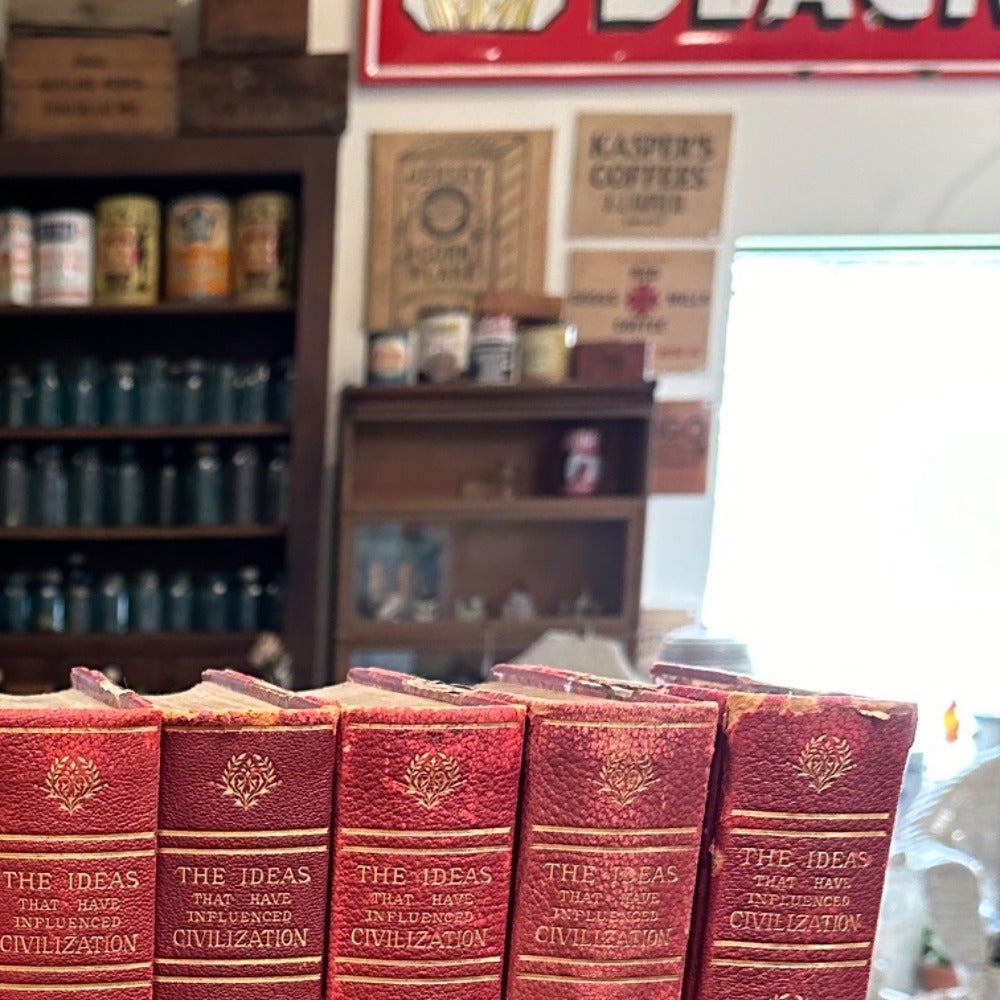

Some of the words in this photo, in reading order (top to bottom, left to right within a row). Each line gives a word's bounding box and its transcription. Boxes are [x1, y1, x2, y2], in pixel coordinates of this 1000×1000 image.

[588, 133, 715, 160] KASPER'S
[588, 163, 708, 191] COFFEES
[740, 847, 793, 868] THE
[806, 851, 870, 868] IDEAS
[3, 871, 52, 891] THE
[68, 871, 140, 891] IDEAS
[176, 866, 226, 886] THE
[240, 866, 311, 886] IDEAS
[356, 864, 405, 885] THE
[423, 867, 493, 886] IDEAS
[753, 875, 796, 889] THAT
[813, 876, 851, 889] HAVE
[19, 897, 59, 912] THAT
[76, 898, 120, 912] HAVE
[192, 892, 232, 906] THAT
[249, 892, 291, 906] HAVE
[372, 892, 414, 906] THAT
[432, 893, 475, 906] HAVE
[746, 892, 850, 907] INFLUENCED
[14, 916, 122, 929] INFLUENCED
[187, 910, 292, 924] INFLUENCED
[365, 909, 475, 924] INFLUENCED
[730, 911, 861, 932] CIVILIZATION
[0, 933, 138, 955] CIVILIZATION
[172, 928, 309, 949] CIVILIZATION
[351, 927, 488, 950] CIVILIZATION
